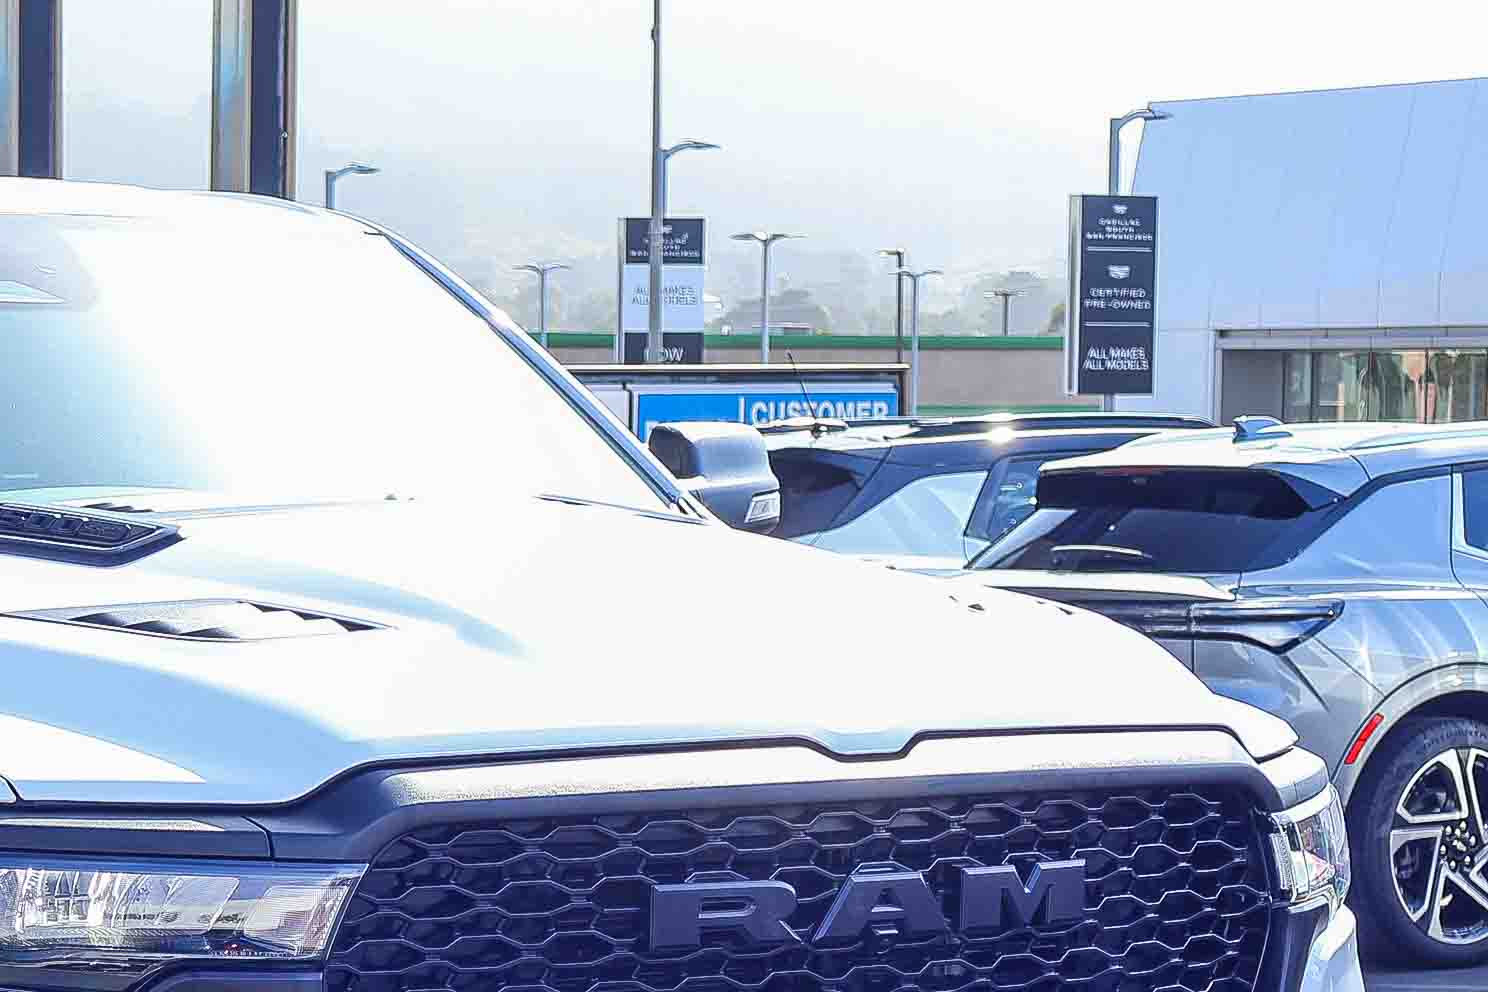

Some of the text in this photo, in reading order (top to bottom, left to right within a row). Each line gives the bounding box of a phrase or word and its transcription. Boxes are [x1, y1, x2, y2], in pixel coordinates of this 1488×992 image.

[1089, 287, 1146, 298] CERTIFIED
[1087, 346, 1146, 360] ALL MAKES
[1082, 359, 1150, 371] ALL MODELS
[752, 400, 889, 425] CUSTOMER
[650, 860, 1085, 954] RAM
